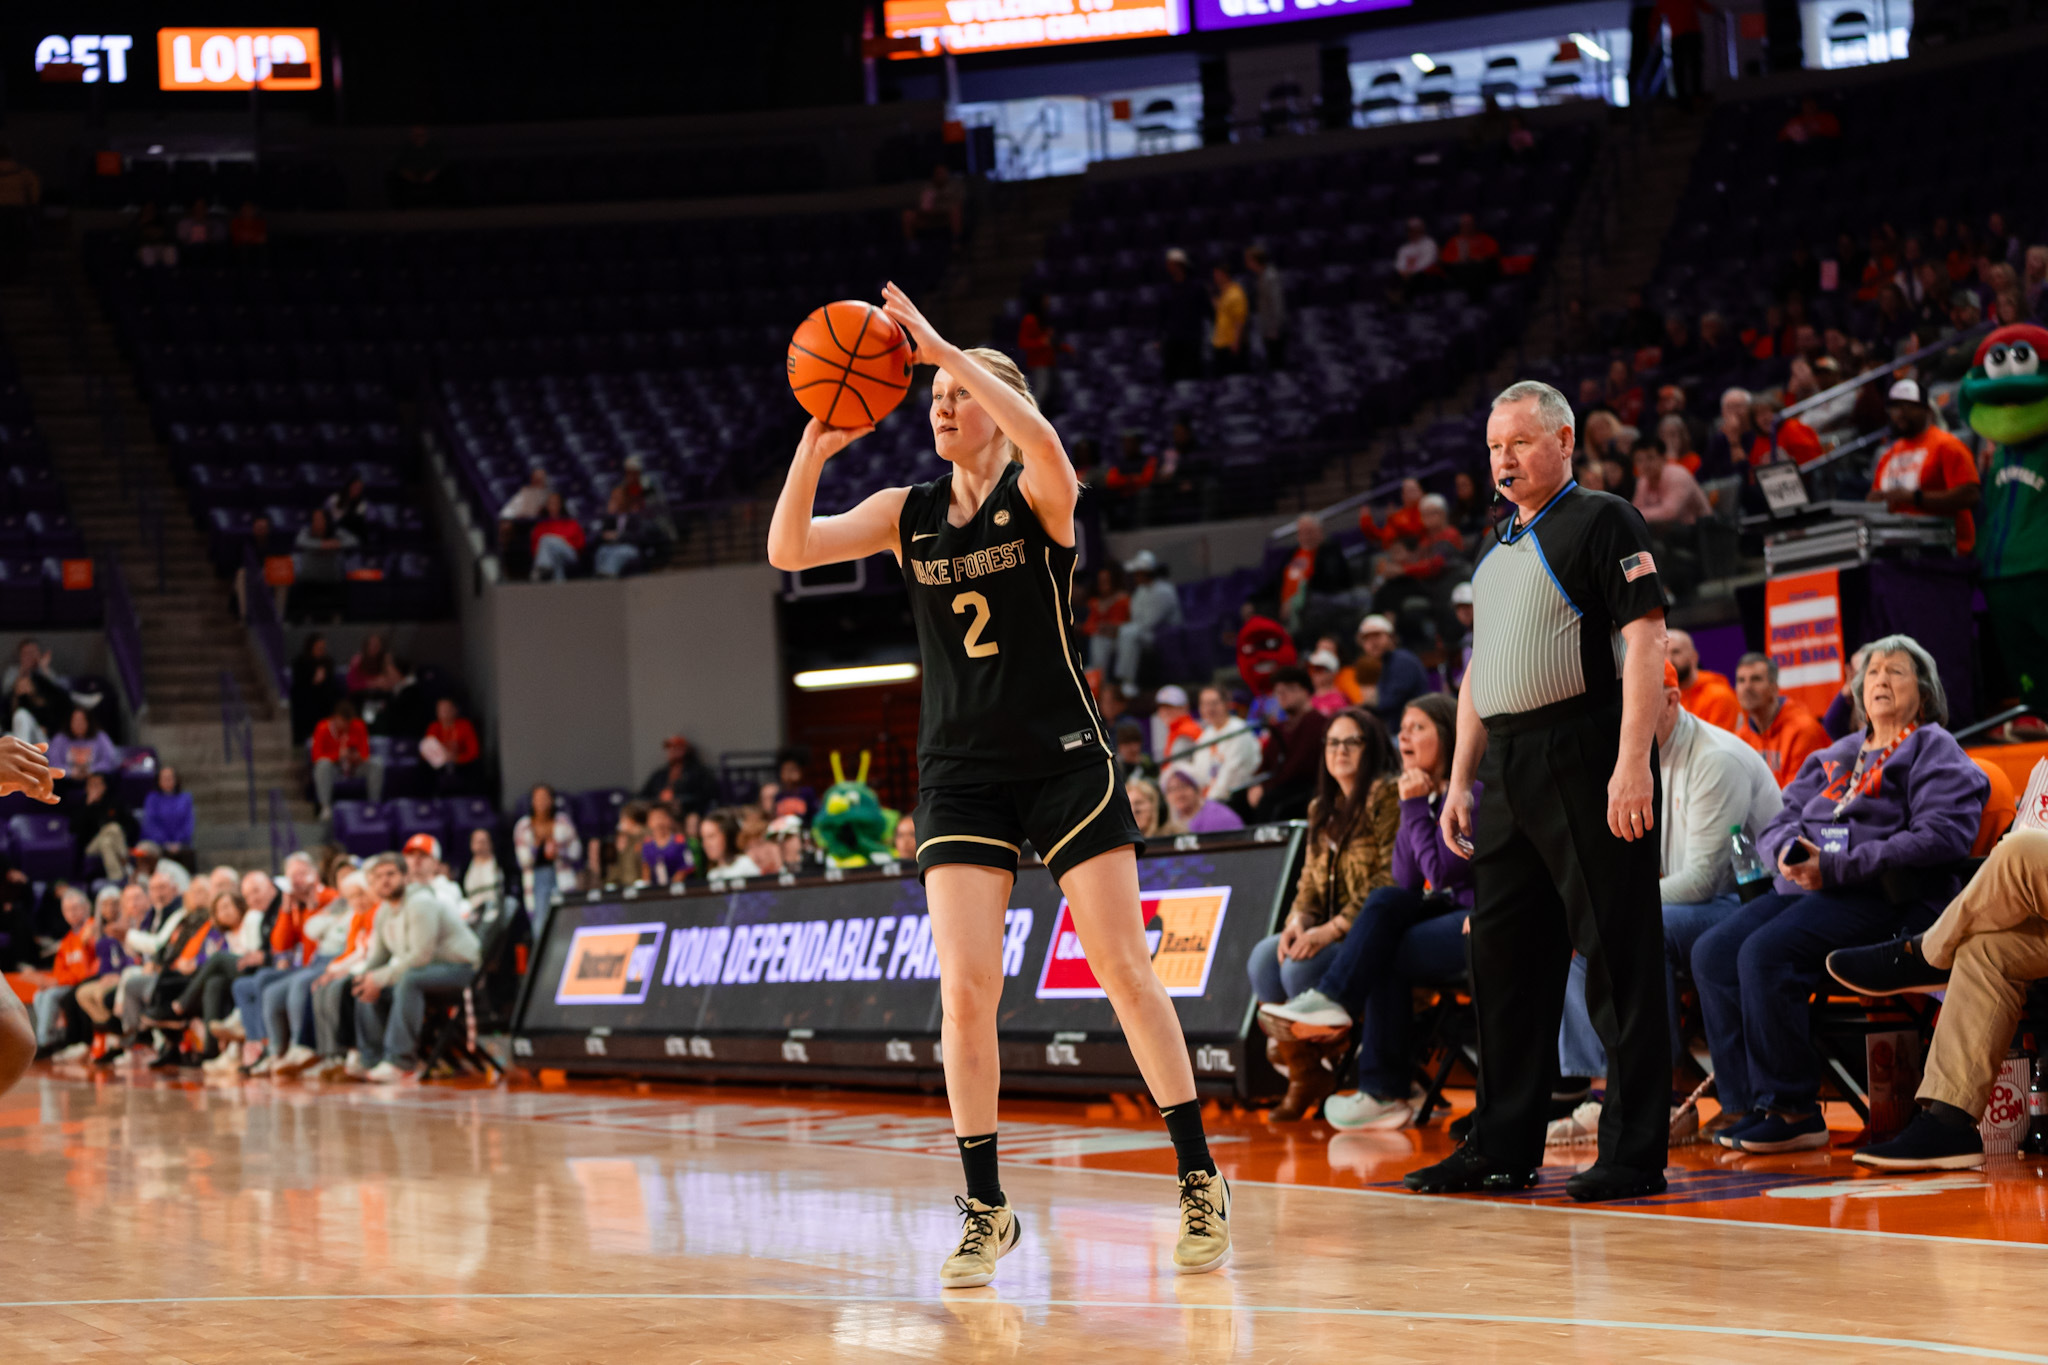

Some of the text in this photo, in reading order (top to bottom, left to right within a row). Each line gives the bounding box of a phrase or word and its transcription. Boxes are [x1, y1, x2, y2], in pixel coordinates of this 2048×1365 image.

[911, 538, 1027, 586] WAKE FOREST
[951, 590, 1000, 659] 2
[1083, 732, 1093, 742] M
[661, 926, 732, 988] YOUR
[721, 916, 897, 985] DEPENDABLE
[1990, 1098, 2024, 1124] CORN
